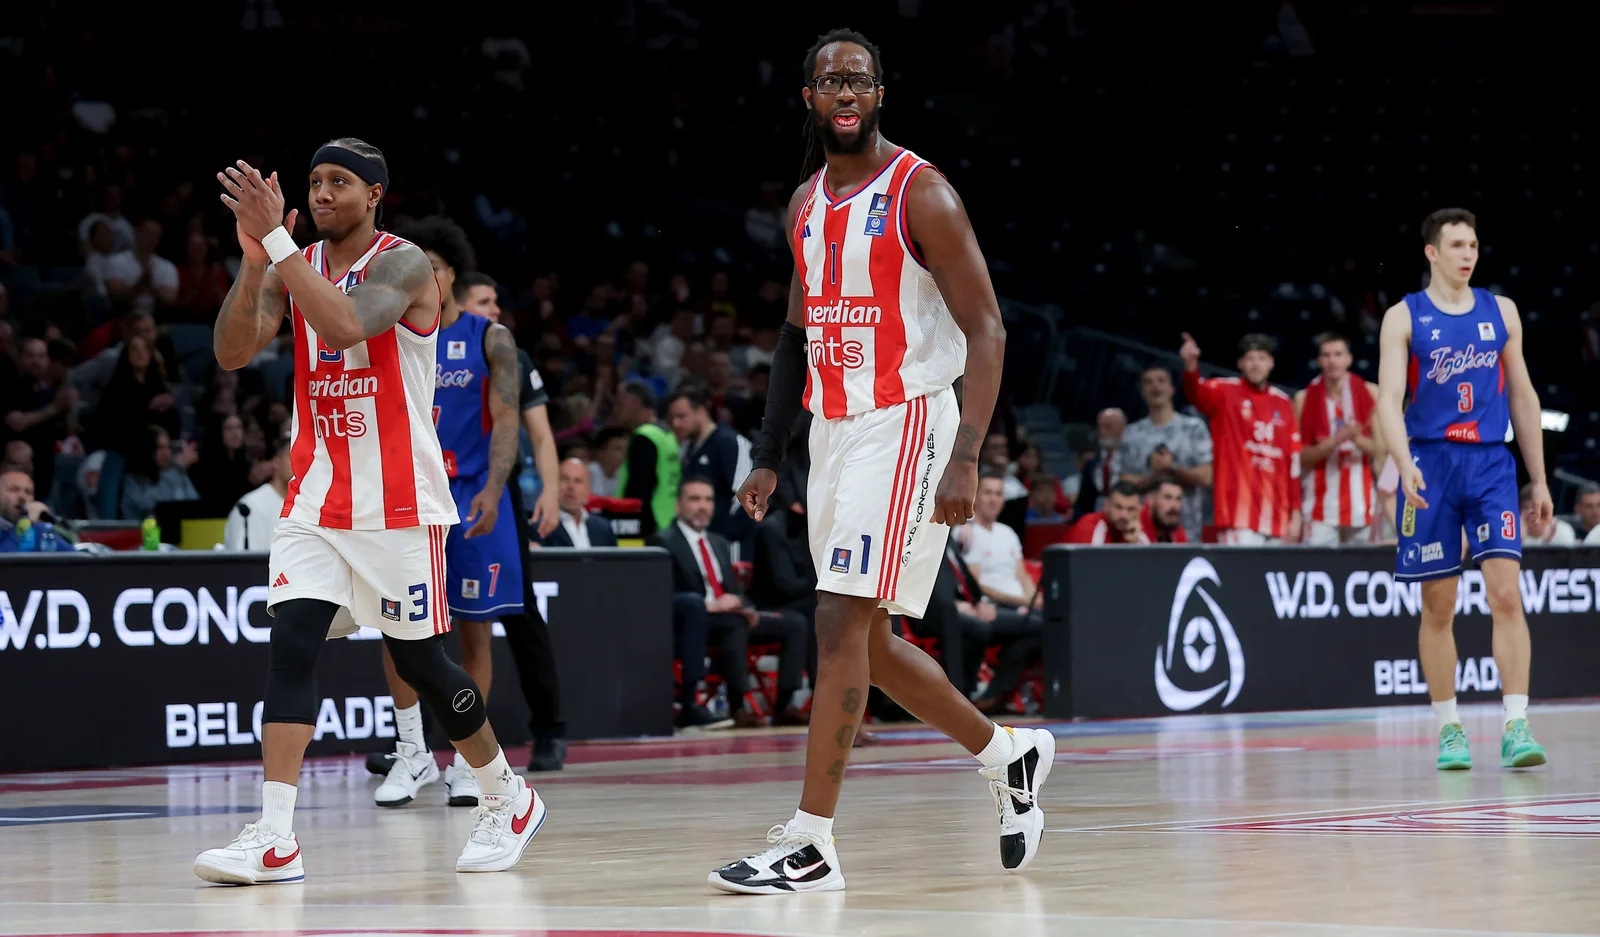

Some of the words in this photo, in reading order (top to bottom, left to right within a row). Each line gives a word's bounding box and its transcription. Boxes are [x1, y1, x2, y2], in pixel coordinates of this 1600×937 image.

[831, 242, 837, 284] 1
[1457, 382, 1474, 413] 3
[926, 428, 936, 461] WES
[1501, 510, 1515, 540] 3
[860, 534, 872, 575] 1
[408, 582, 429, 622] 3
[1265, 571, 1339, 619] W.D.
[1345, 570, 1491, 617] CONR
[0, 589, 101, 651] W.D.
[1374, 657, 1502, 695] BELAD
[165, 696, 397, 747] BELADE
